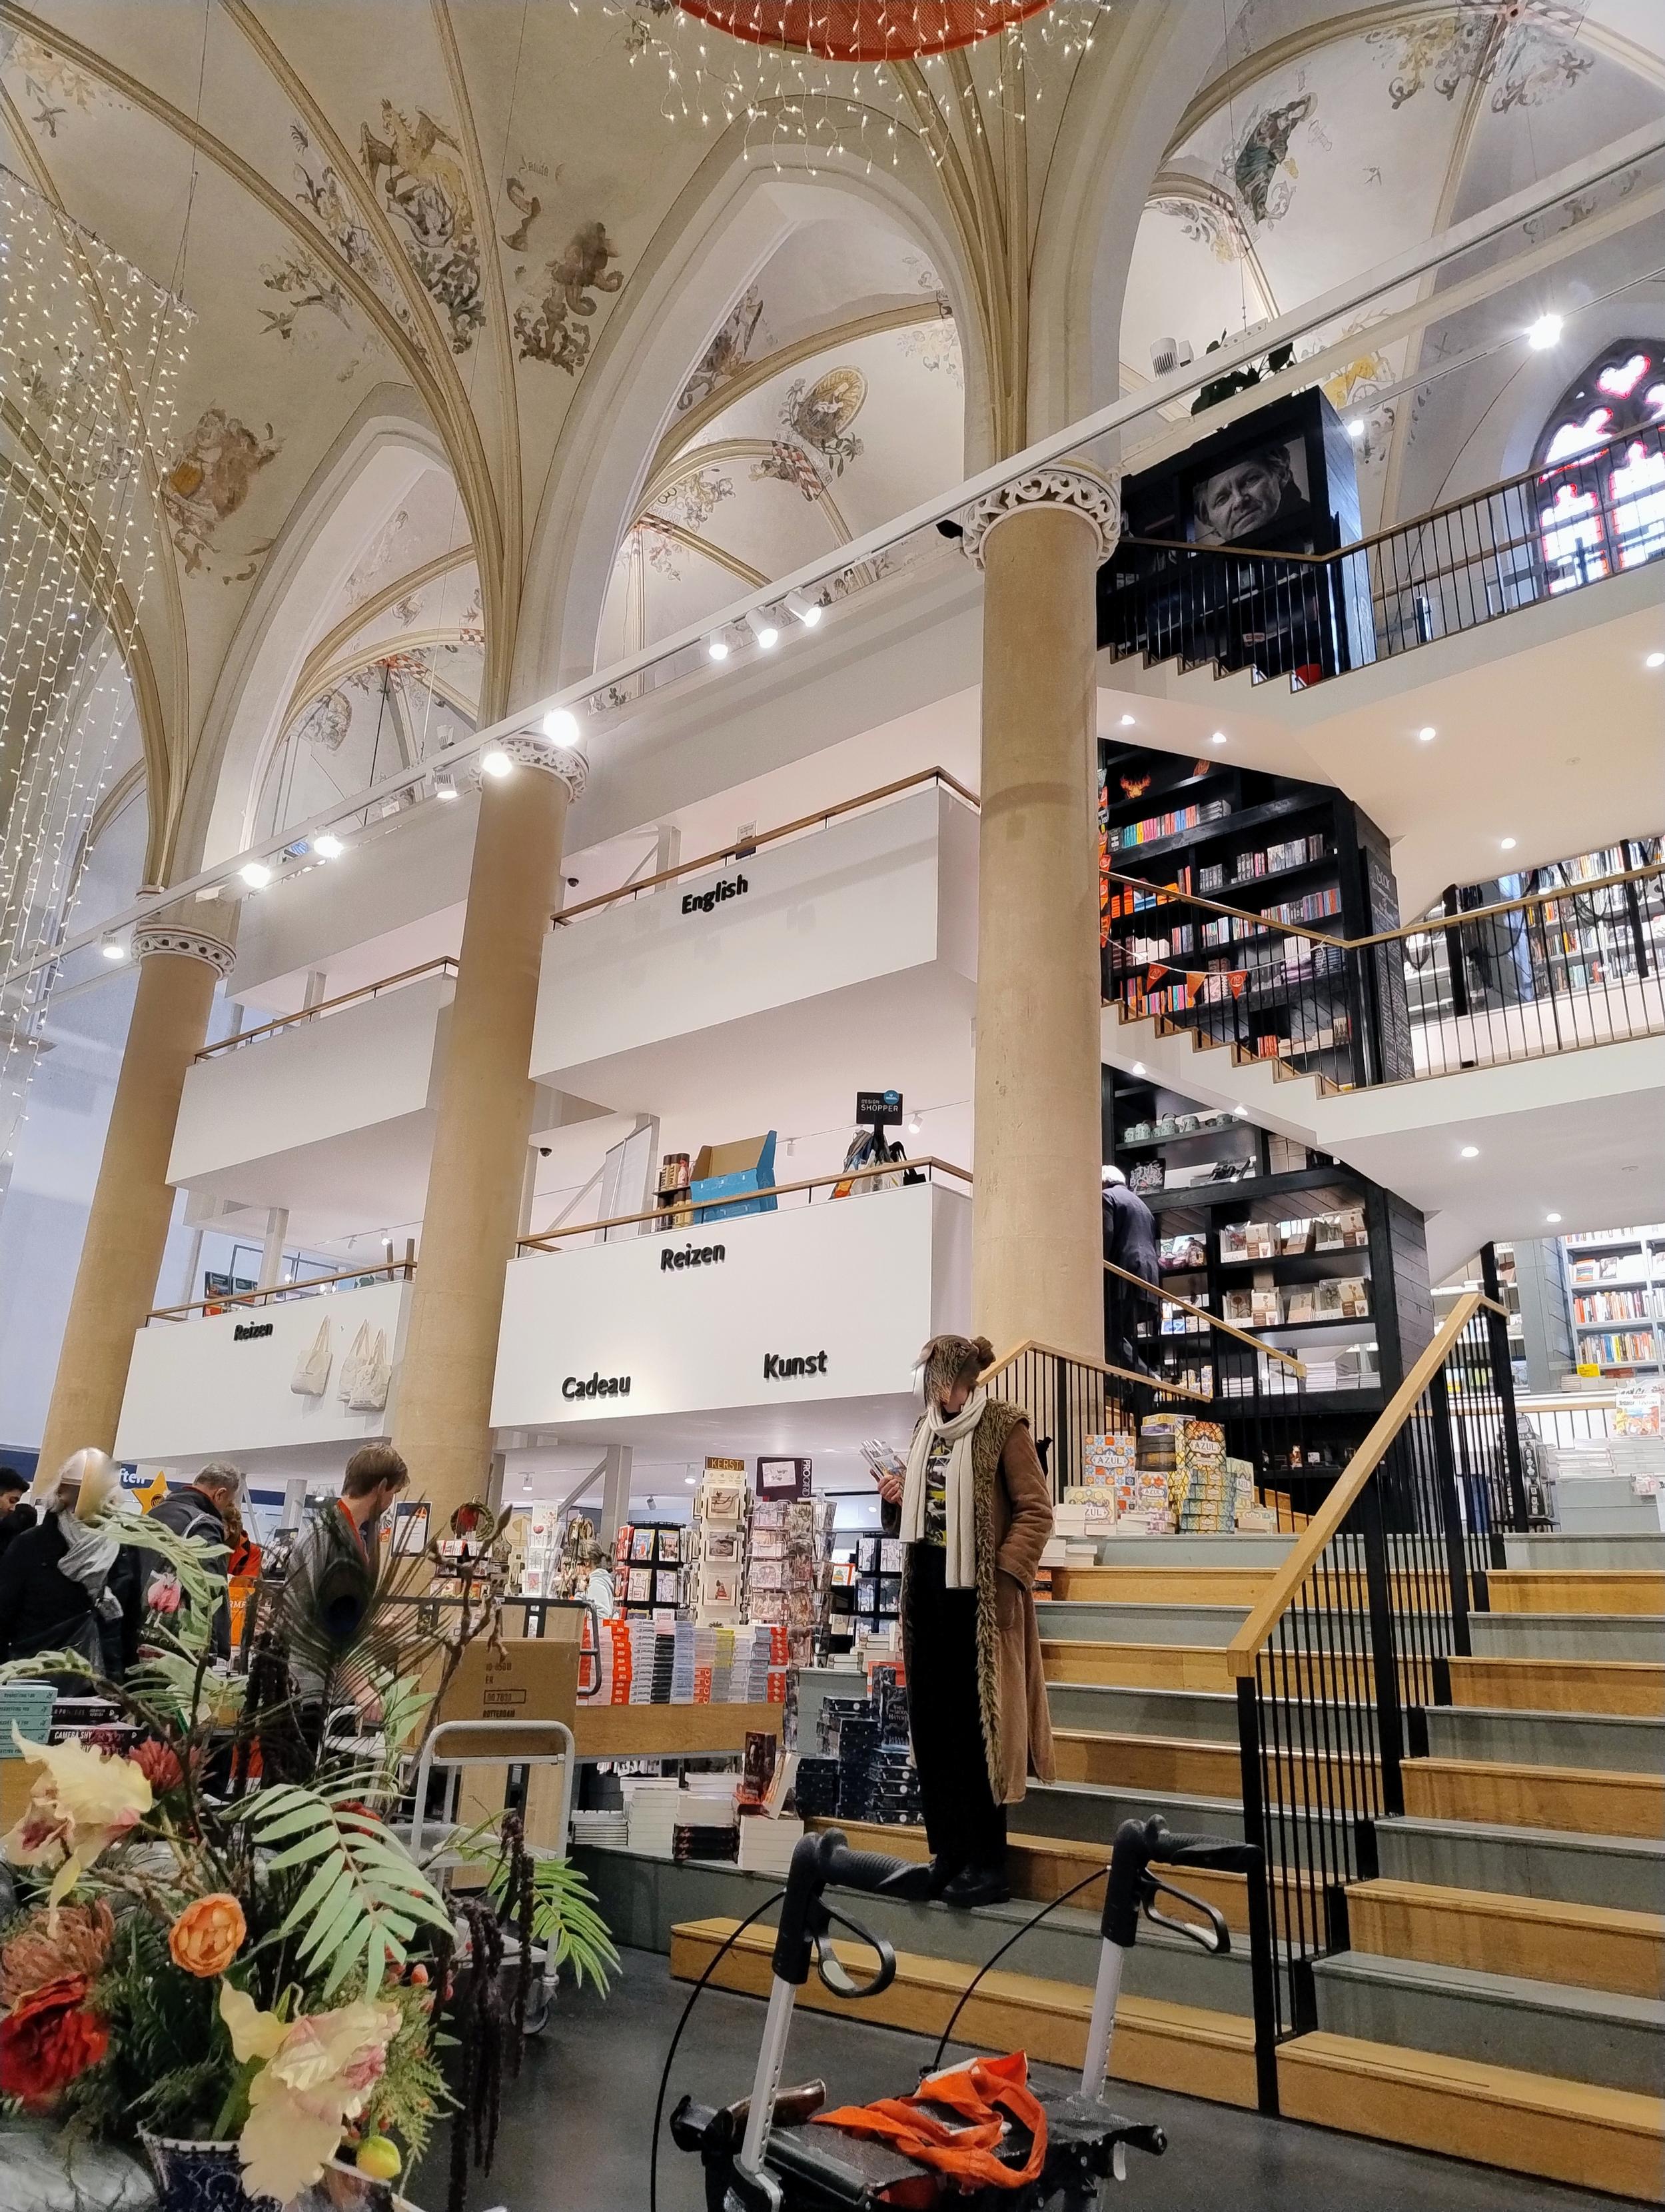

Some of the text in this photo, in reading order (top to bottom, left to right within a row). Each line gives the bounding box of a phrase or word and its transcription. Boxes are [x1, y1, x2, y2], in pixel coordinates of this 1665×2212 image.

[682, 874, 748, 914] English
[861, 1104, 899, 1112] SHOPPER
[660, 1242, 726, 1270] Reizen
[233, 1320, 273, 1341] Reizen
[763, 1350, 828, 1379] Kunst
[562, 1372, 631, 1398] Cadeau
[1195, 1442, 1216, 1451] AZUL
[710, 1459, 741, 1470] KERST
[1097, 1456, 1122, 1465] AZUL
[482, 1709, 515, 1718] ROTTERDAM
[54, 1731, 79, 1739] CAMERA
[79, 1731, 93, 1739] SHY
